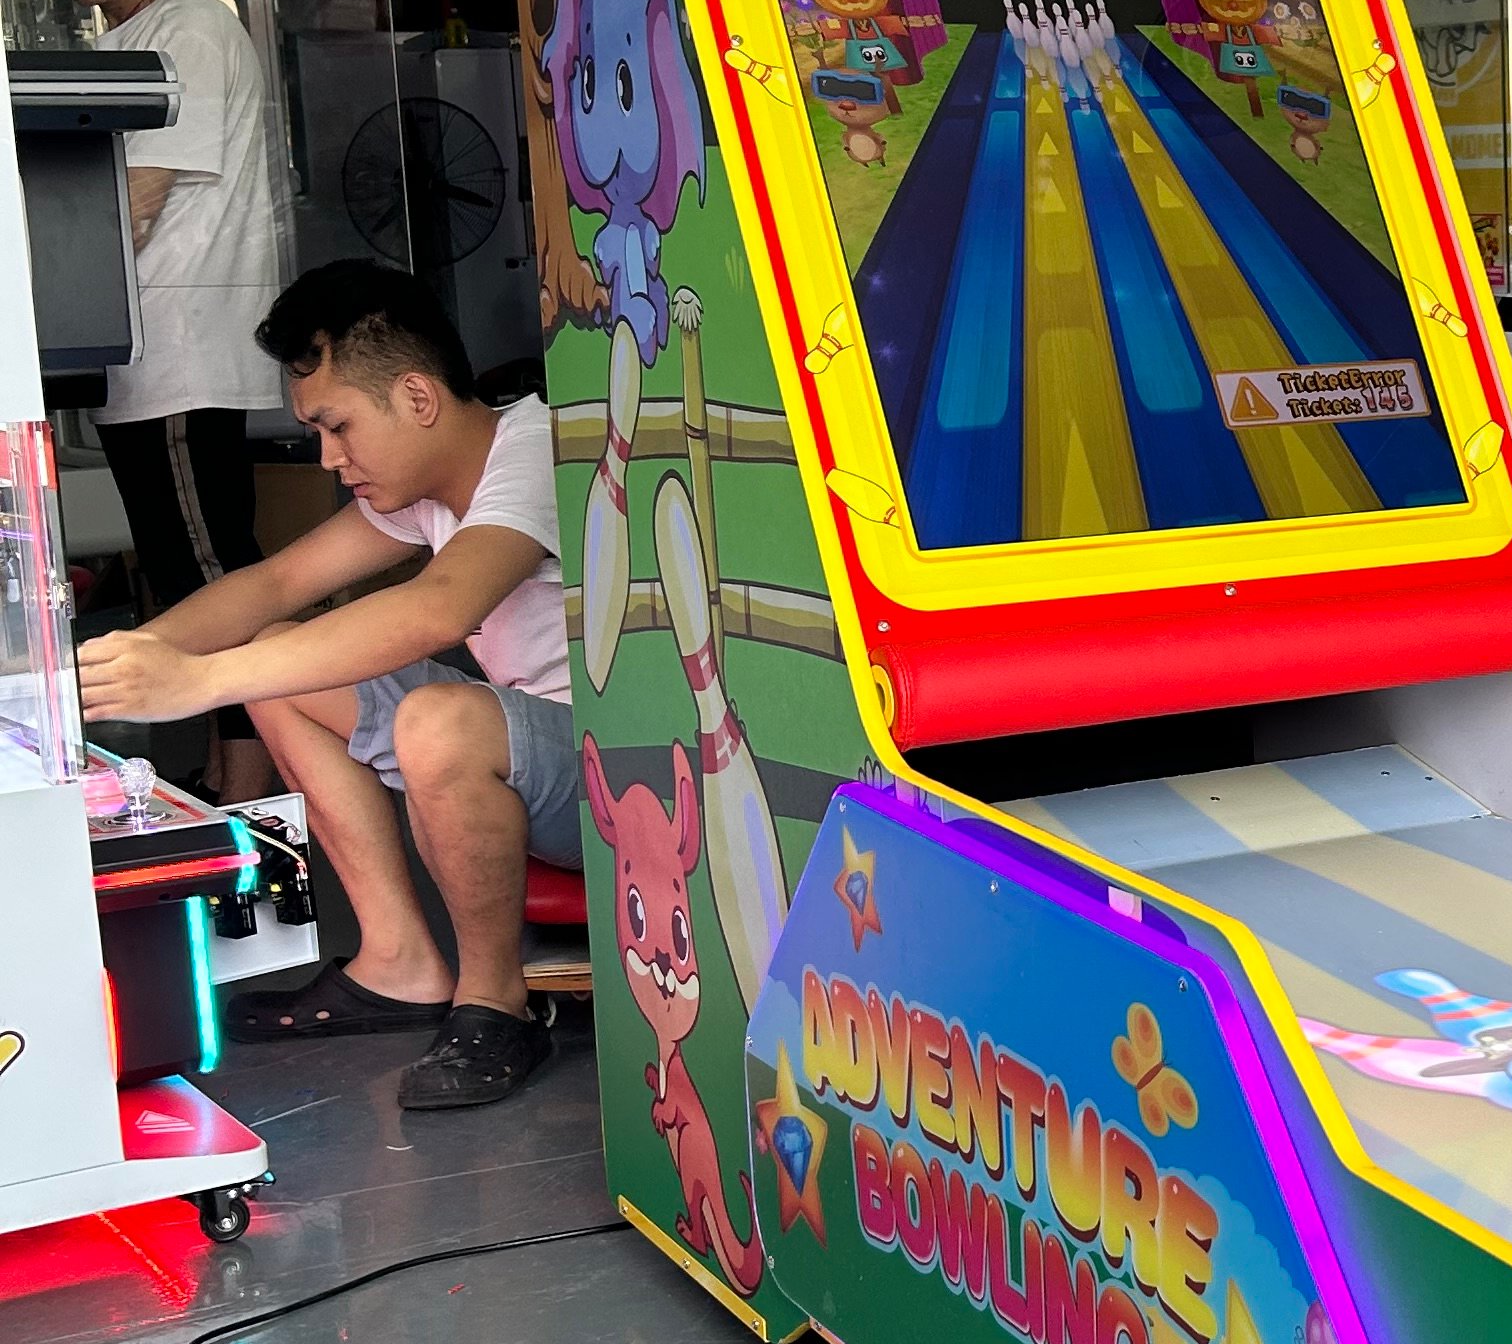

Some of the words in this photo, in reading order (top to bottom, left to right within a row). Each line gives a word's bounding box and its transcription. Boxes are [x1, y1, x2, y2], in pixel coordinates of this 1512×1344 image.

[1277, 368, 1406, 394] TicketError
[1287, 396, 1363, 418] Ticket:
[1361, 385, 1414, 413] 145
